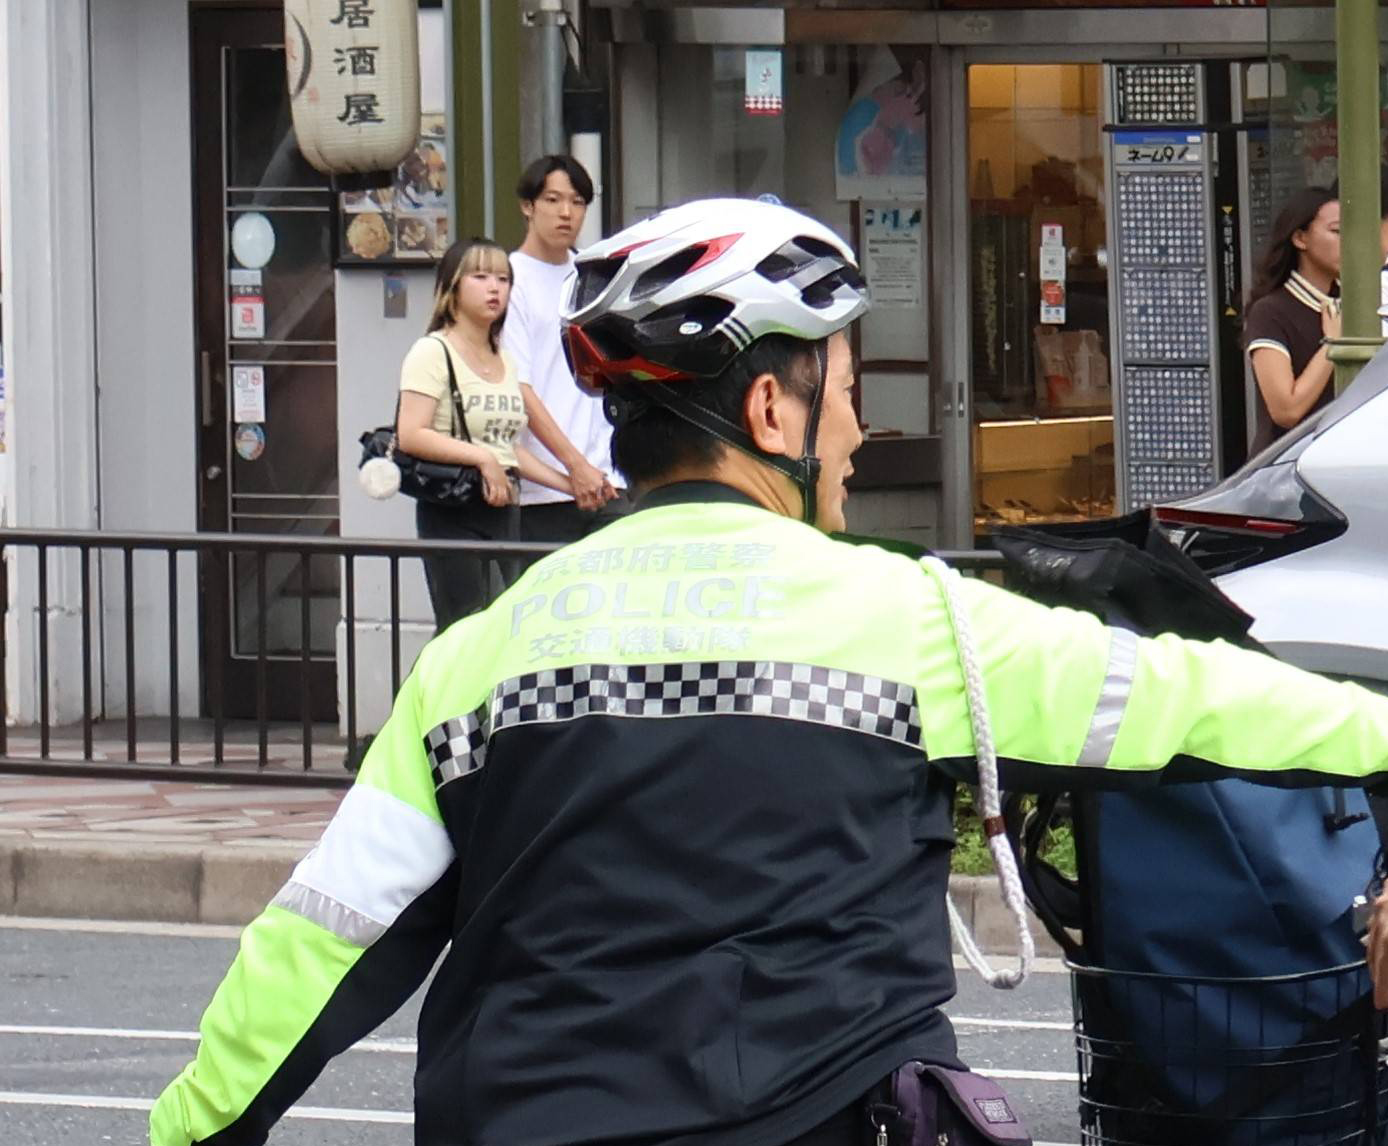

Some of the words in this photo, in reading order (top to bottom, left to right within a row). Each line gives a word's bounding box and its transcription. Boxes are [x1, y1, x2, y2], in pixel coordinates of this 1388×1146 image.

[330, 0, 385, 126] 居酒屋
[531, 542, 777, 587] 京都府警察
[509, 575, 787, 639] POLICE
[527, 626, 753, 663] 交通機動隊
